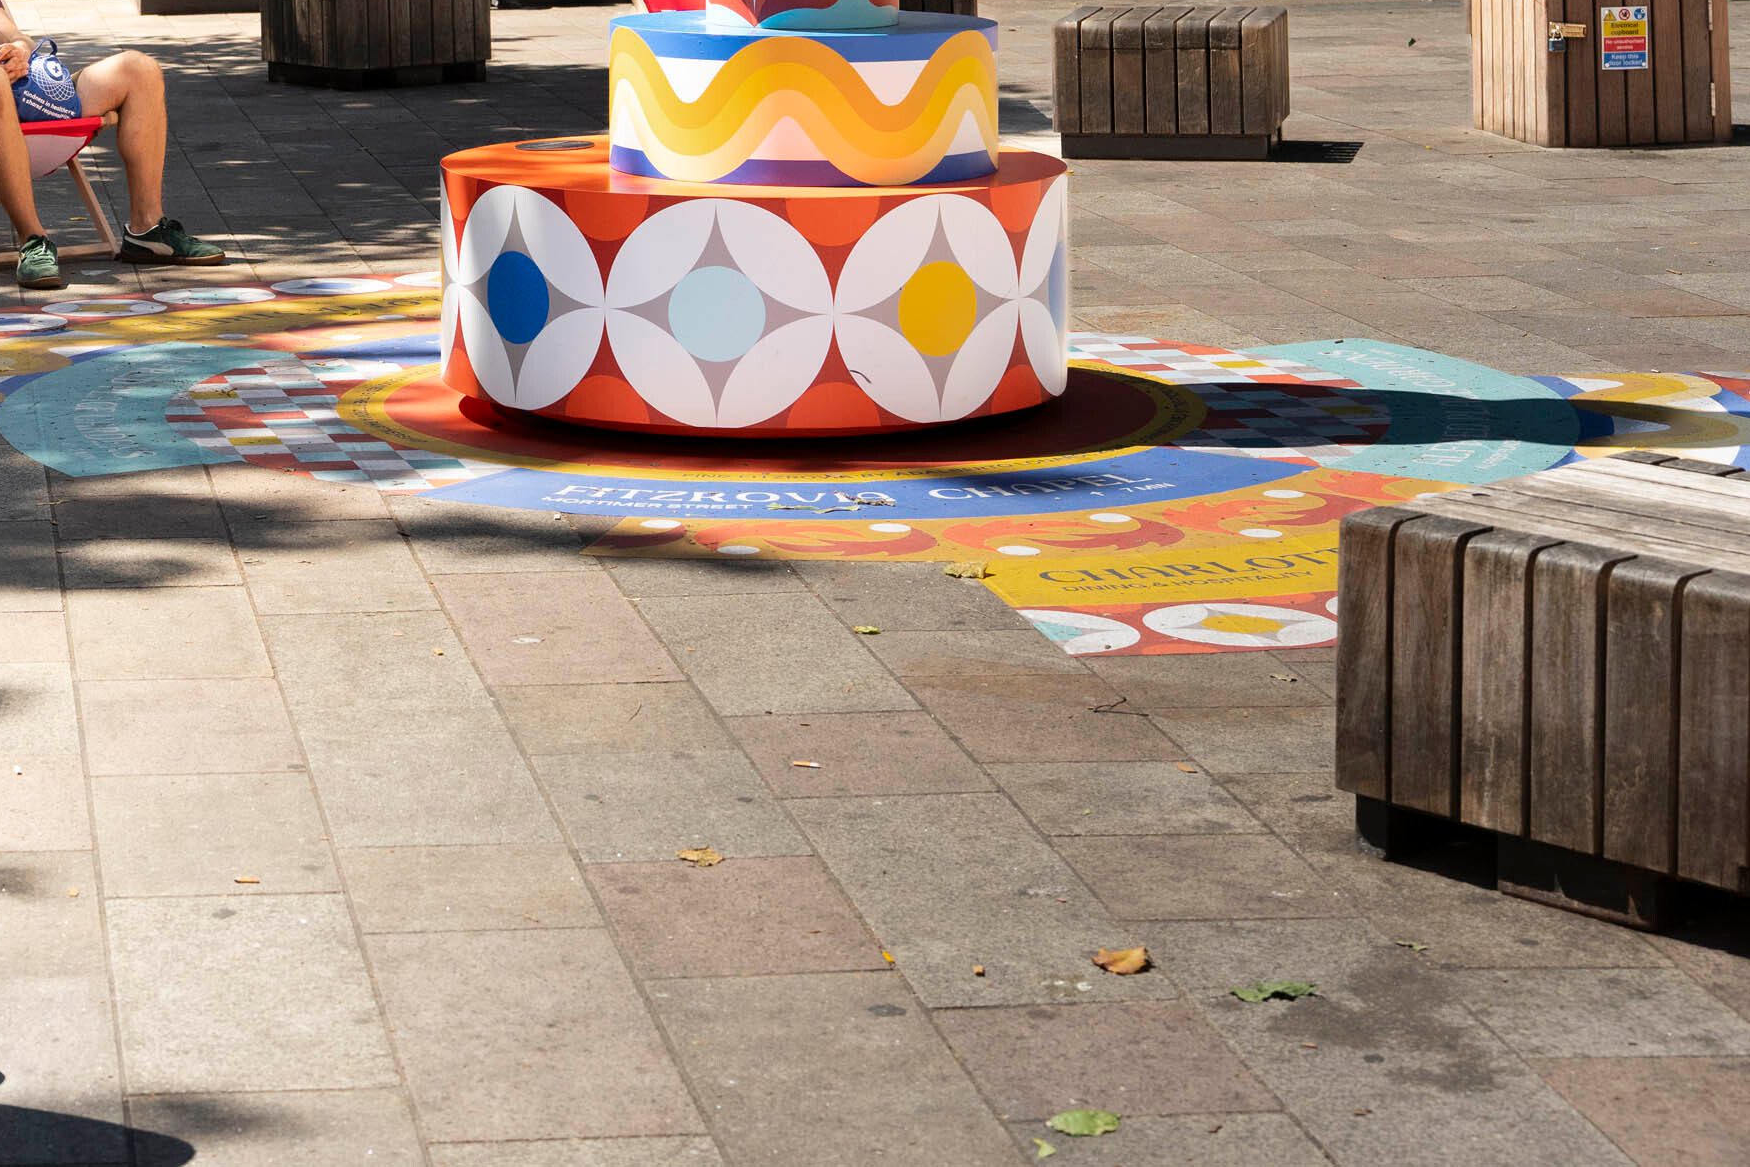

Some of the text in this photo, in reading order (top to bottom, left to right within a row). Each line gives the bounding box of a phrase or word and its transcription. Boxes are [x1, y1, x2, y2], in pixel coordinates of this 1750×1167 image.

[23, 90, 44, 105] Kindness
[554, 473, 1153, 503] FITZROVIA CHAPEL
[541, 495, 753, 510] MORTIMER STREET
[1061, 569, 1314, 593] DINING & HOSPITALITY
